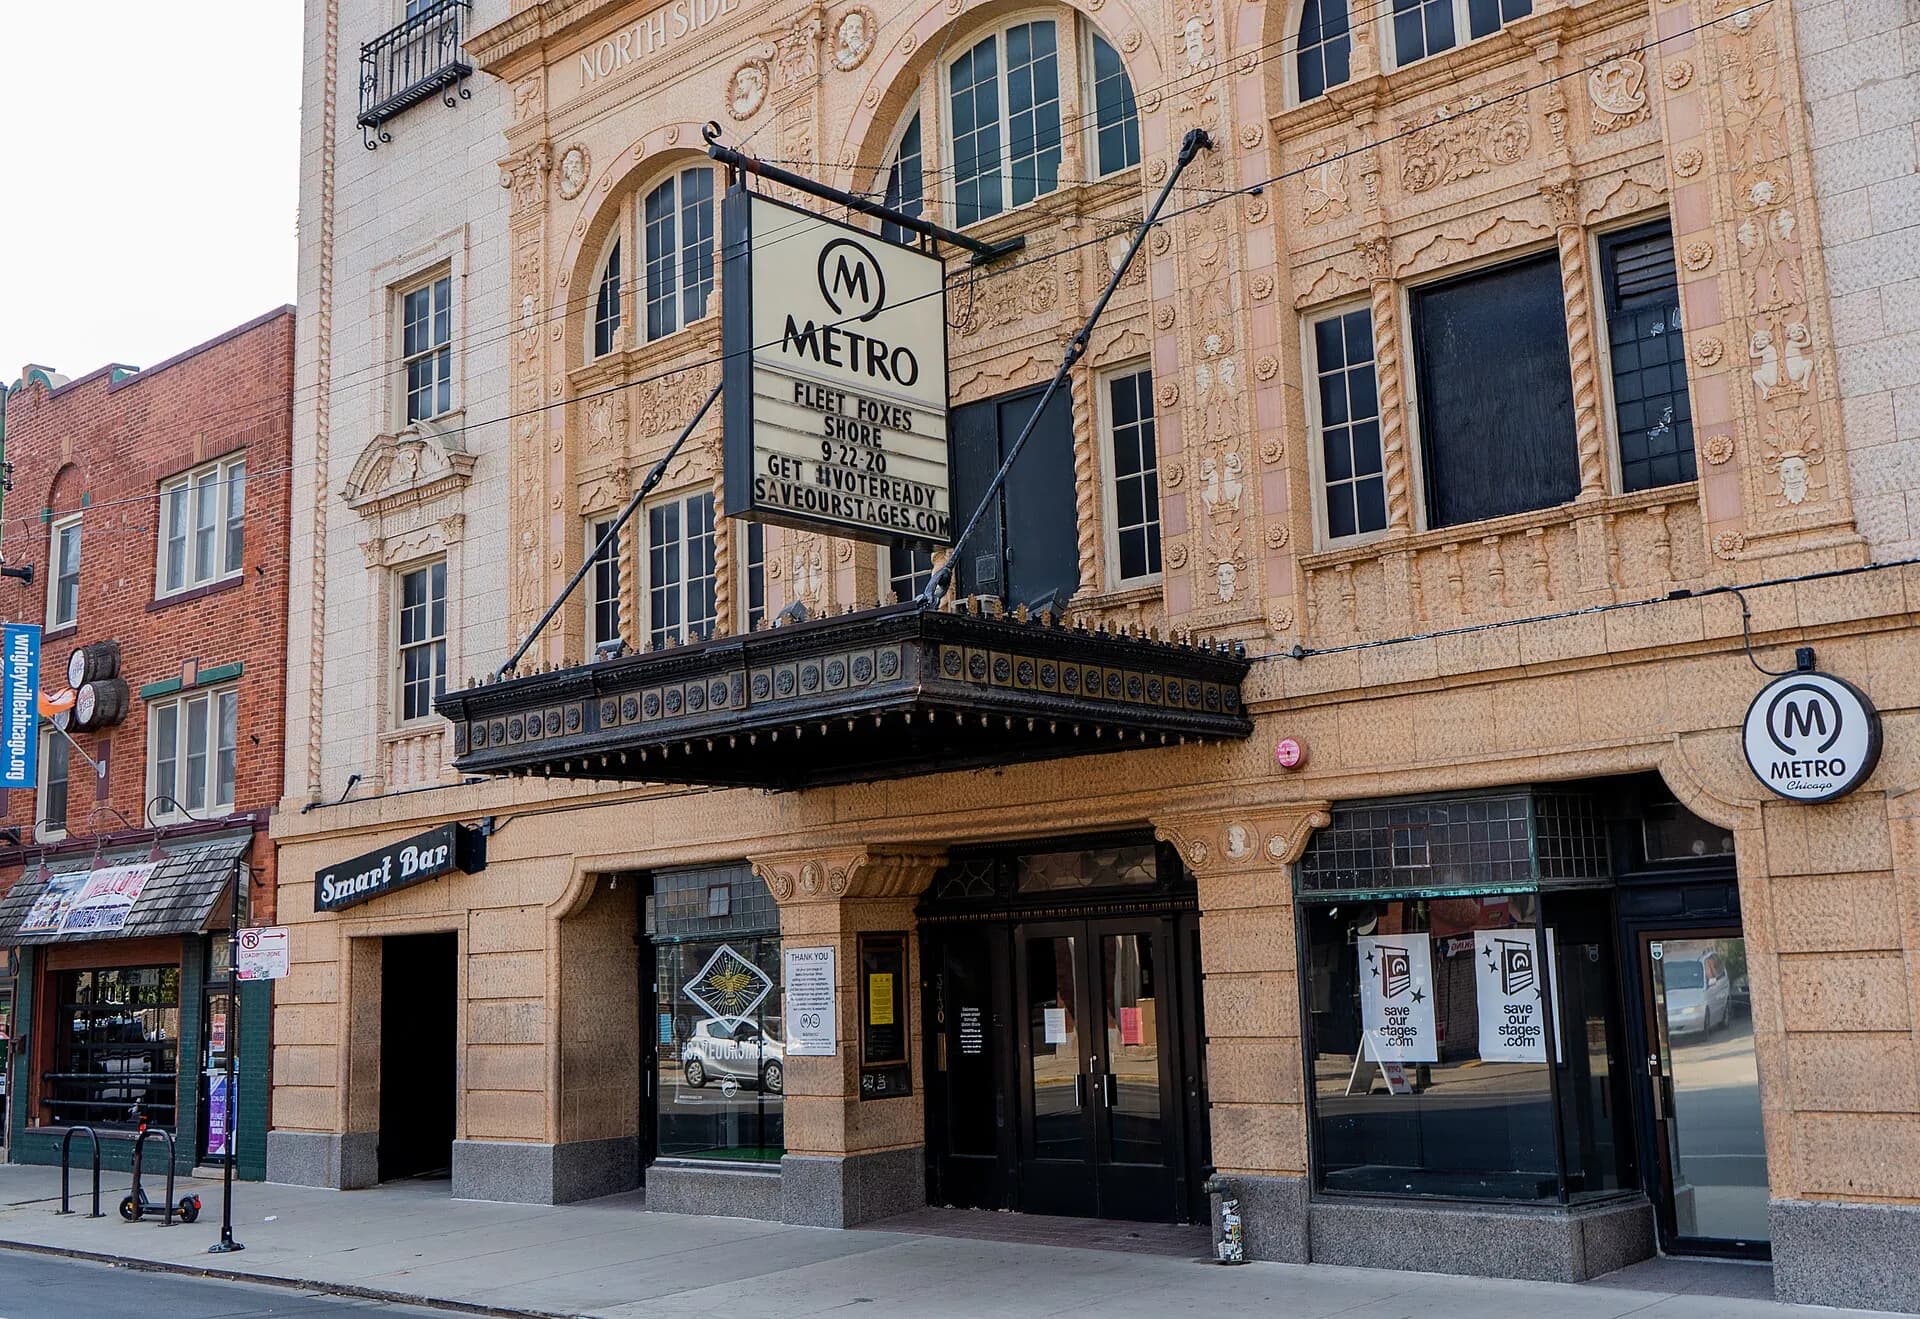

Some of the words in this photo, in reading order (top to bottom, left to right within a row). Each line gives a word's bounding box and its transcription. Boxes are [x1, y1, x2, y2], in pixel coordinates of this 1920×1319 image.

[579, 11, 667, 88] NORTH
[782, 314, 919, 386] METRO
[793, 382, 845, 415] FLEET
[858, 399, 912, 431] FOXES
[824, 416, 882, 449] SHORE
[821, 440, 887, 474] 9-22-20
[767, 454, 803, 481] GET
[755, 478, 950, 537] SAVEOURSTAGES.COM
[6, 634, 33, 780] wrigleyvillechicago.org
[1770, 758, 1846, 780] METRO
[1786, 780, 1832, 792] Chicago
[320, 855, 392, 903] Smart
[399, 844, 448, 877] Bar
[791, 953, 813, 961] THANK
[814, 952, 828, 961] YOU
[1384, 1006, 1410, 1016] save
[1503, 1003, 1533, 1014] save
[1388, 1016, 1407, 1026] our
[1508, 1015, 1530, 1025] our
[1379, 1025, 1417, 1039] stages
[1498, 1023, 1541, 1038] stages
[1385, 1036, 1414, 1047] .com
[1503, 1036, 1536, 1047] .com
